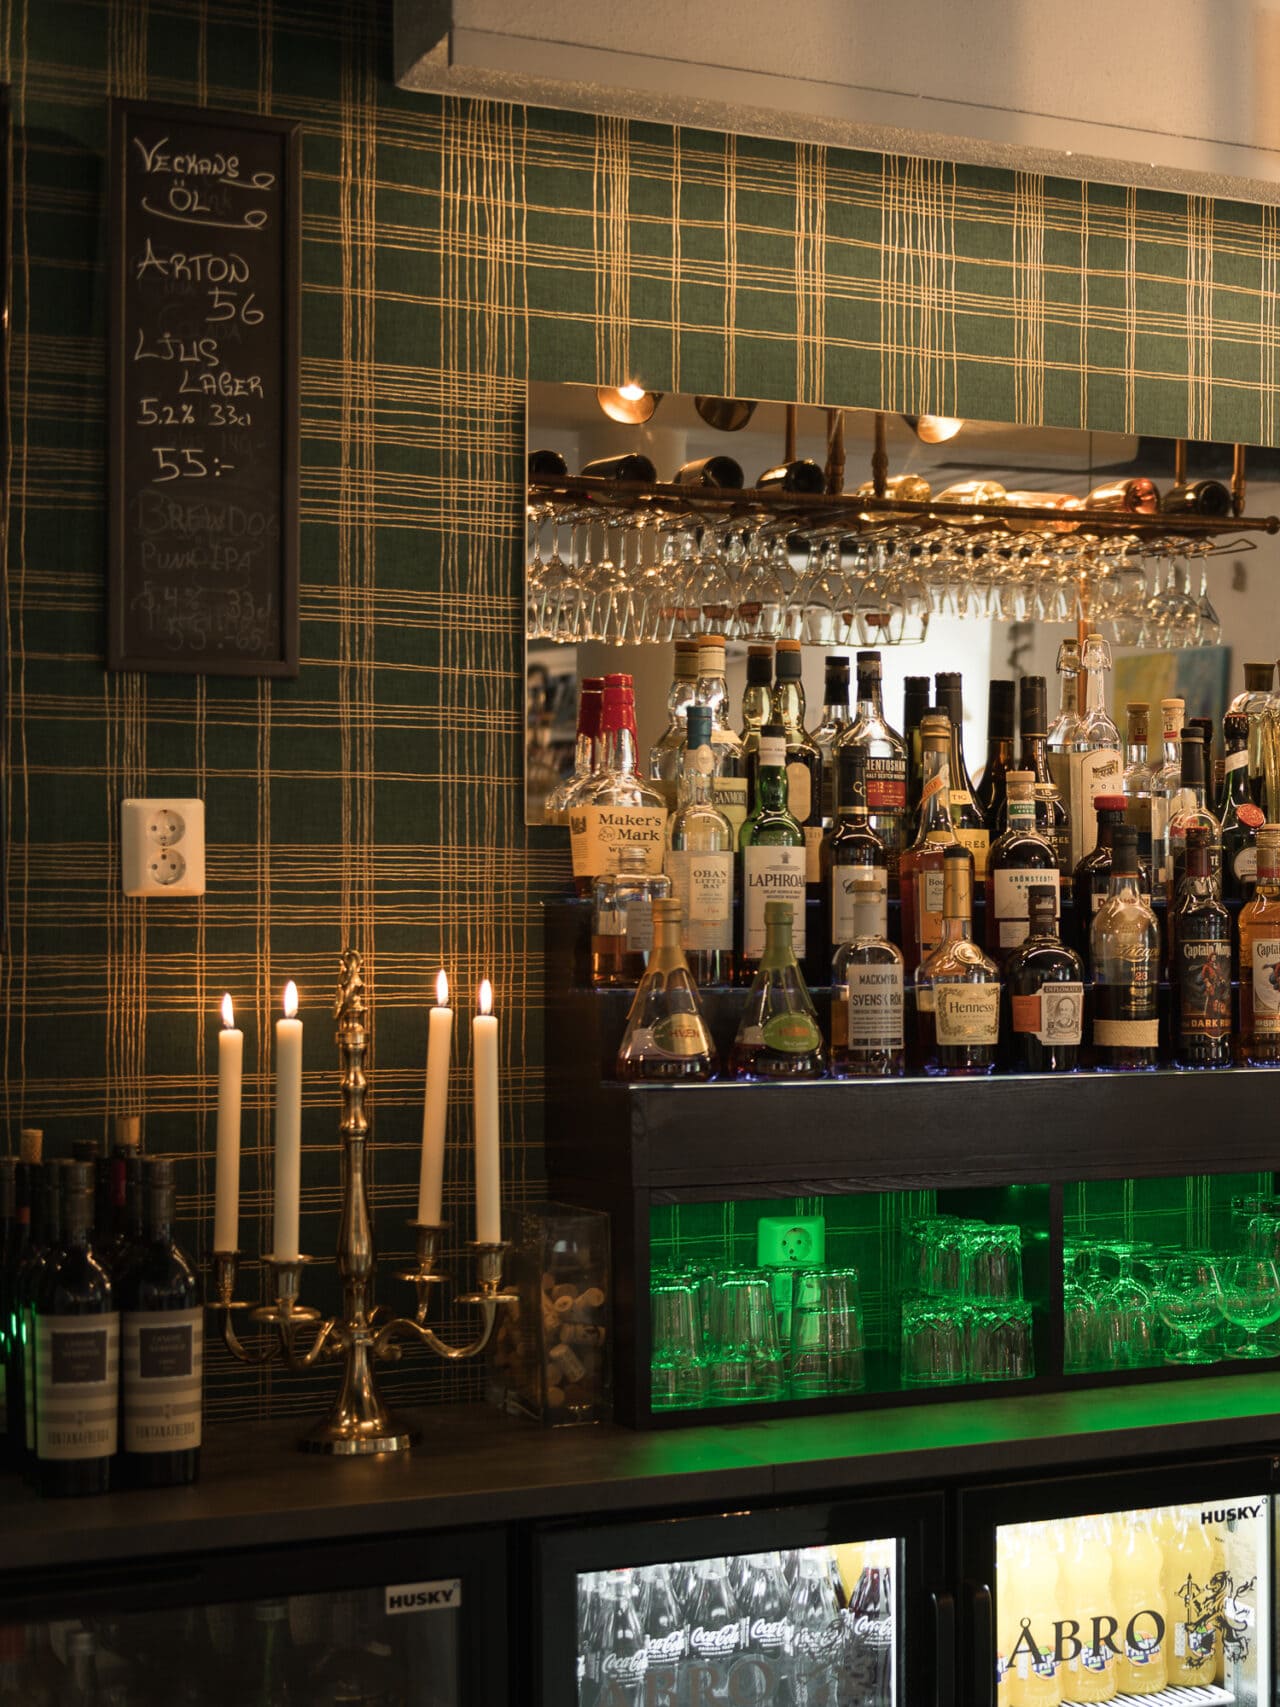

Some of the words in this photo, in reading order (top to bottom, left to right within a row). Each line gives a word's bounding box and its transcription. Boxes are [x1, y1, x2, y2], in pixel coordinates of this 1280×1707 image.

[169, 178, 211, 211] ÖL
[204, 286, 264, 325] 56
[178, 369, 264, 399] LAGER
[598, 813, 662, 827] Maker's
[618, 829, 660, 842] Mark
[1191, 1019, 1218, 1027] DARK
[1201, 1505, 1261, 1525] HUSKY
[389, 1588, 453, 1608] HUSKY
[1007, 1609, 1166, 1669] ÅBRO
